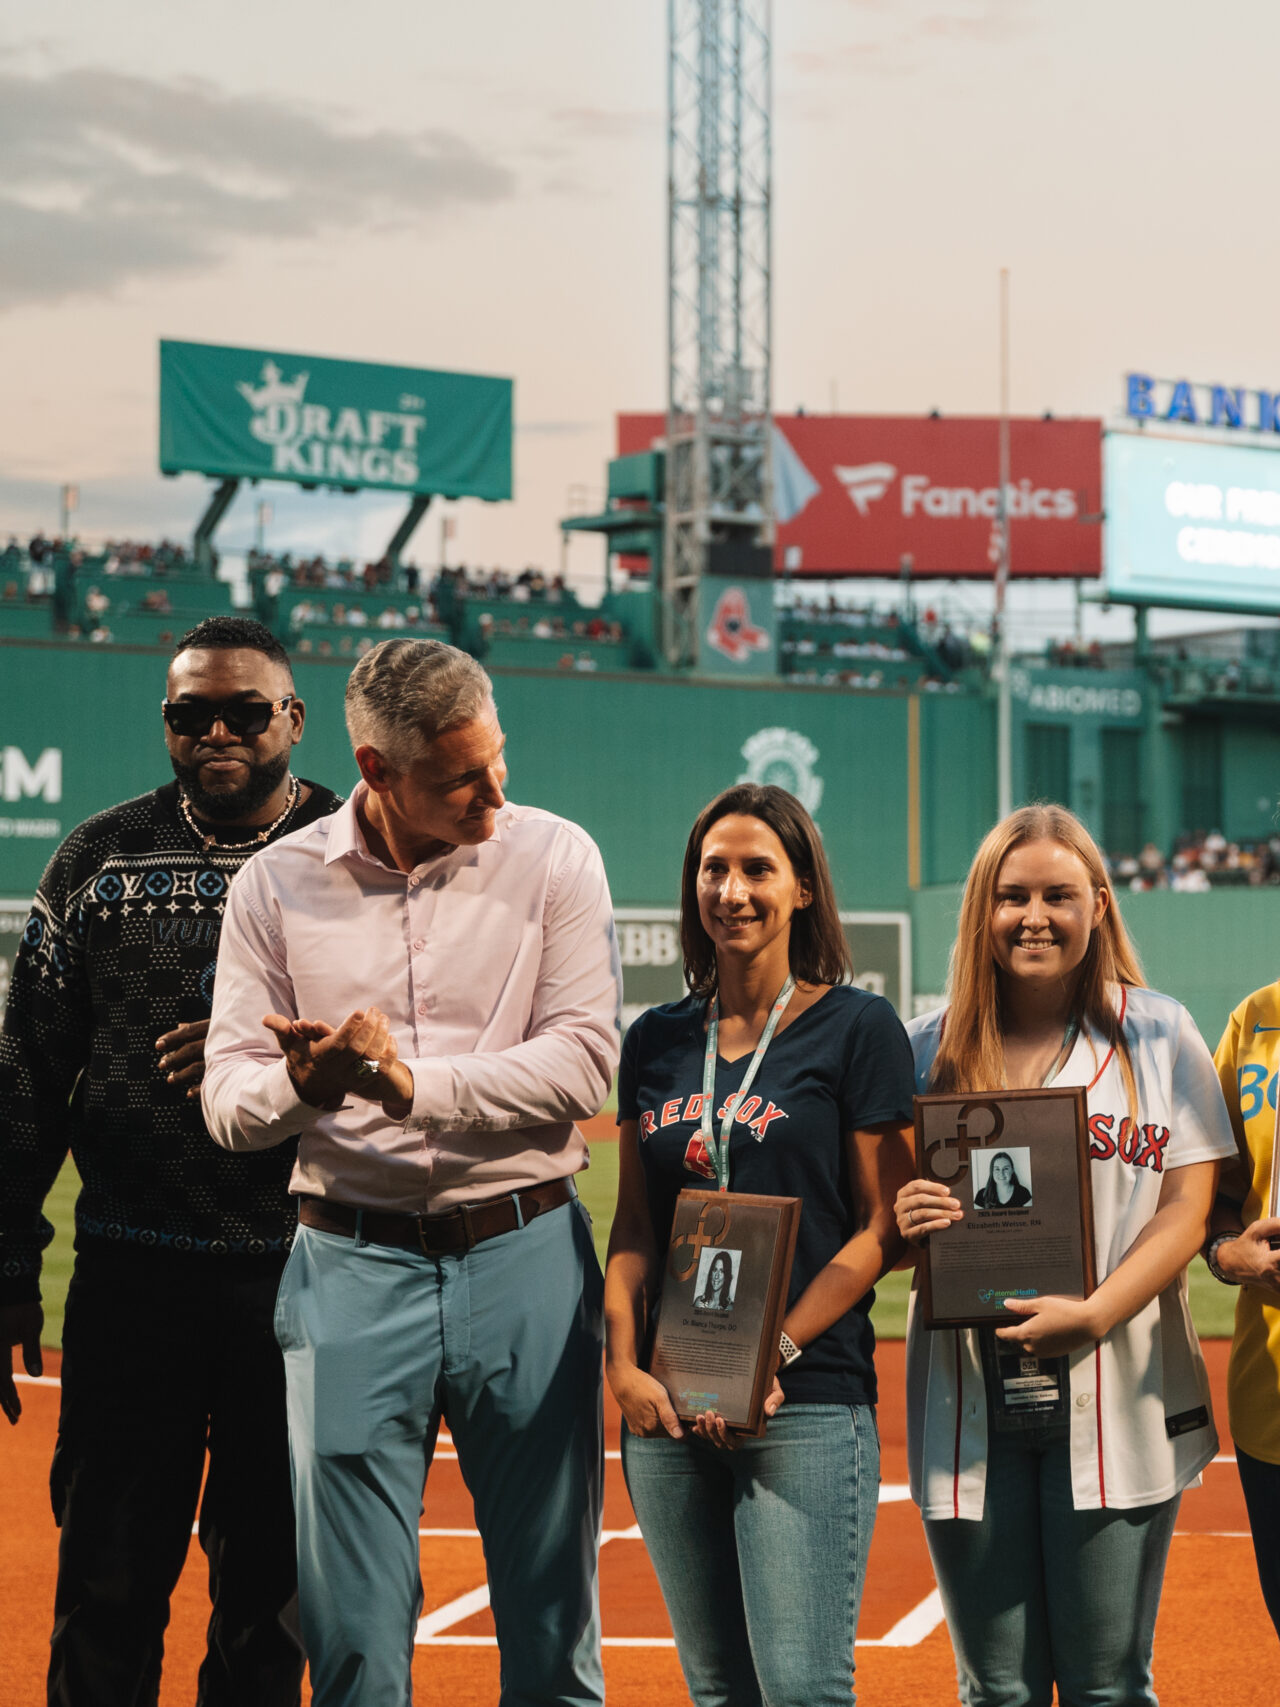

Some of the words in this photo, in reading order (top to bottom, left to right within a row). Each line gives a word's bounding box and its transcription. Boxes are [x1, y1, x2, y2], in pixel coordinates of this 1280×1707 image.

[250, 400, 426, 448] DRAFT
[273, 444, 420, 485] KINGS
[902, 475, 1077, 519] Fanatics
[1029, 685, 1142, 717] ABIOMED
[0, 746, 62, 803] M
[151, 917, 222, 947] VUI
[615, 924, 679, 966] BB
[640, 1093, 704, 1142] RED
[717, 1093, 786, 1138] SOX
[1088, 1113, 1170, 1173] SOX
[967, 1221, 1000, 1230] Elizabeth
